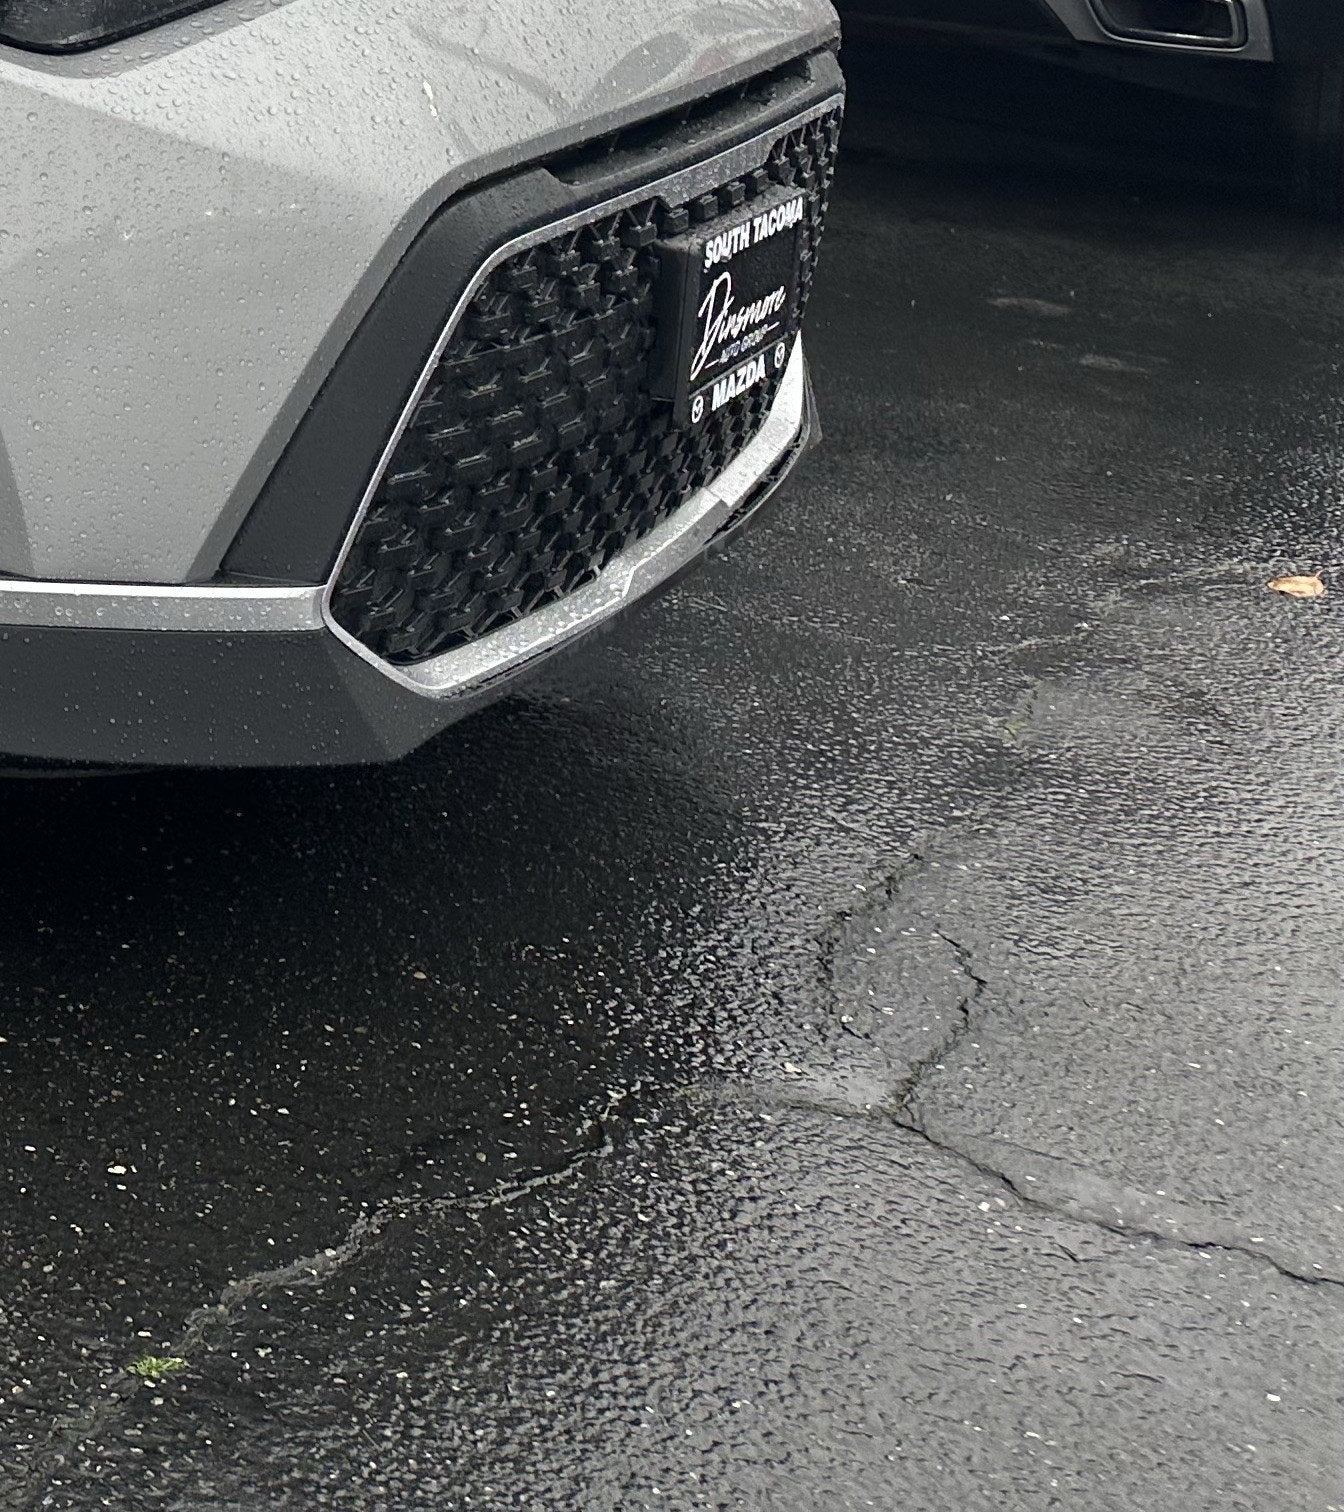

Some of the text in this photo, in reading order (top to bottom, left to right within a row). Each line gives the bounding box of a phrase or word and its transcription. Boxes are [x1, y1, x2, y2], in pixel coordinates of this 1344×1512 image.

[704, 196, 804, 269] SOUTH TACOMA
[689, 271, 787, 381] Dinsmore
[712, 354, 766, 412] MAZDA
